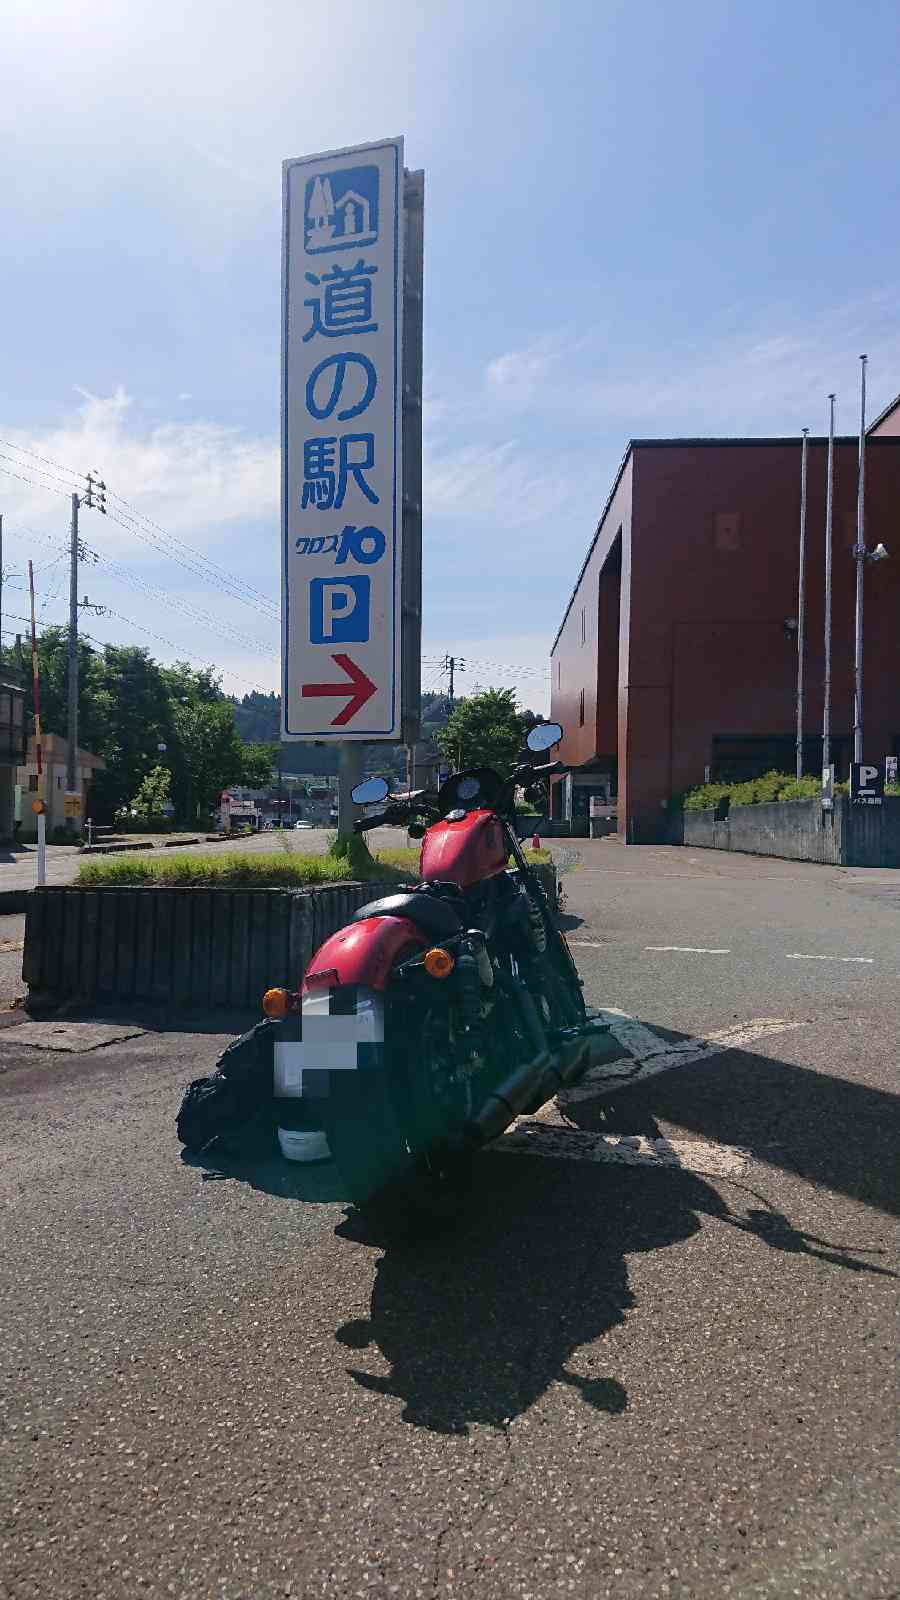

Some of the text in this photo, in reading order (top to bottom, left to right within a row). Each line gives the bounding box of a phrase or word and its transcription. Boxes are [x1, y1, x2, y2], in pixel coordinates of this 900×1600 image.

[302, 259, 379, 511] 道の駅
[322, 583, 357, 637] P
[859, 766, 879, 787] P
